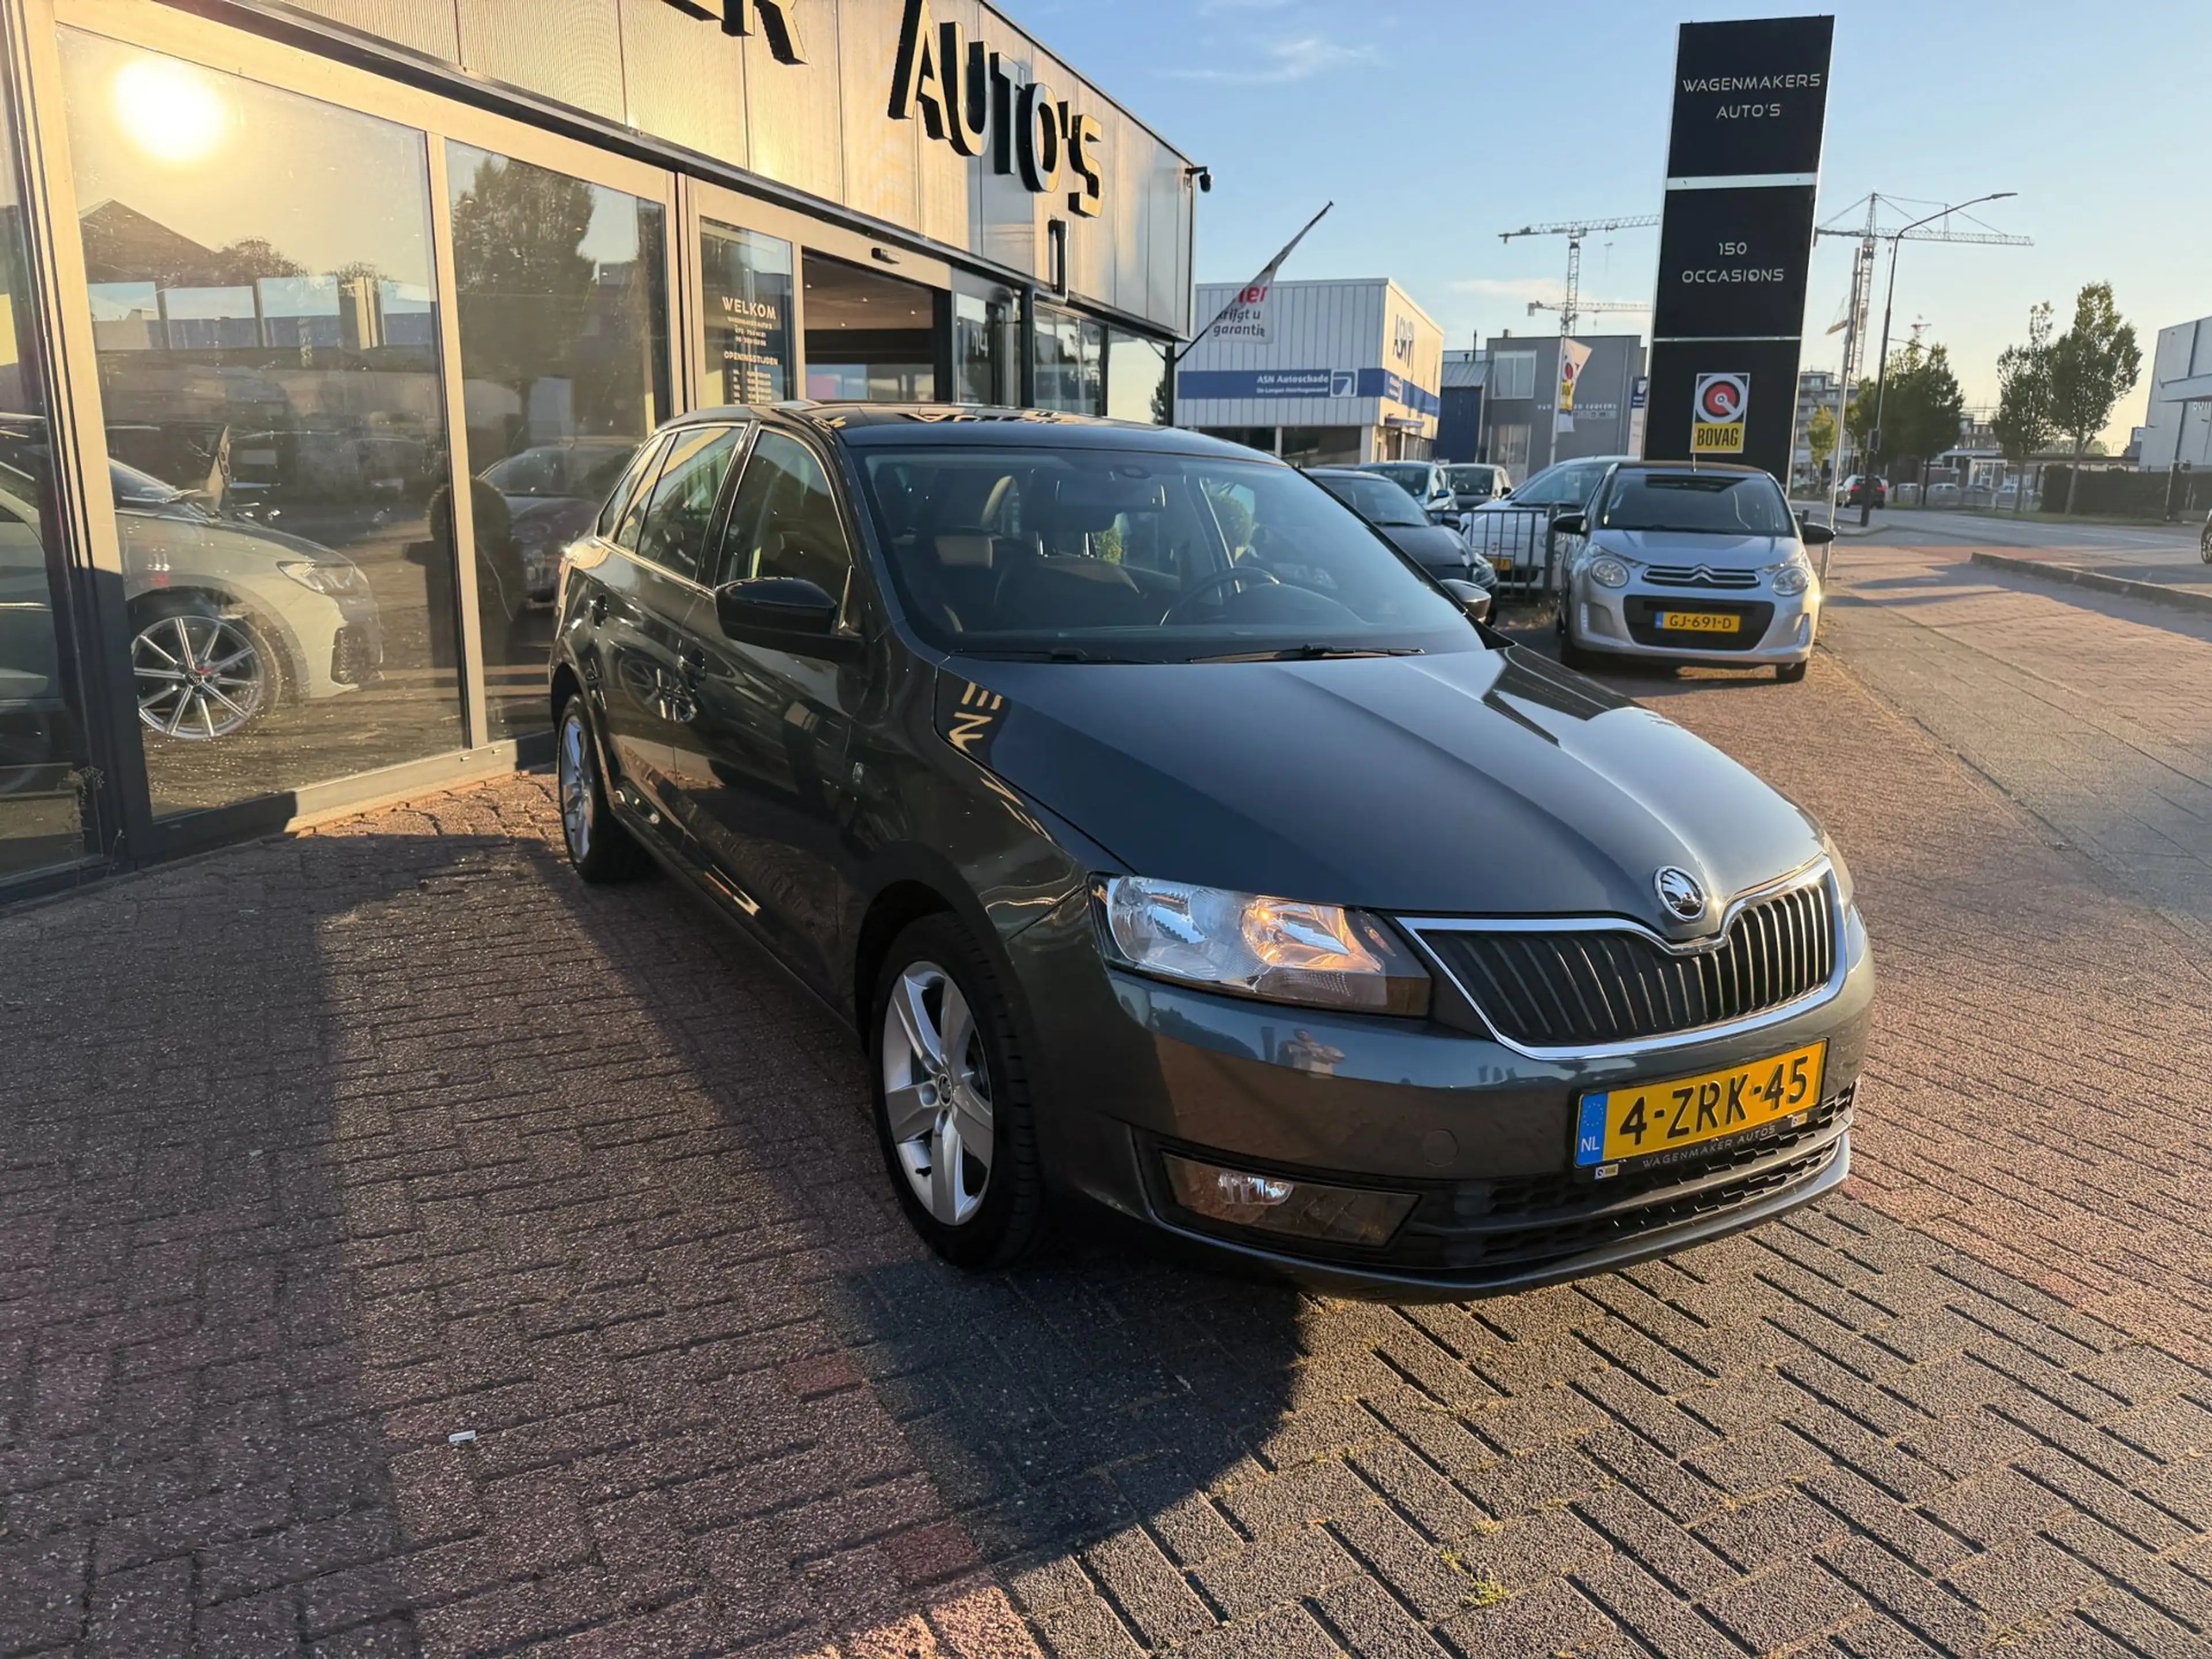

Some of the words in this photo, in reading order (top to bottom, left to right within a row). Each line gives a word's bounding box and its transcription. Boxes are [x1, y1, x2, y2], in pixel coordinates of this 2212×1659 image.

[1683, 73, 1821, 93] WAGENMAKERS
[1715, 103, 1781, 120] AUTO'S
[1718, 242, 1748, 255] 150
[1681, 268, 1785, 283] OCCASIONS
[722, 296, 777, 320] WELKOM
[1253, 310, 1260, 320] u
[1213, 324, 1266, 338] garantie
[1257, 376, 1274, 384] ASN
[1277, 374, 1328, 384] Autoschade
[1696, 427, 1738, 446] BOVAG
[1669, 615, 1732, 629] GJ-691-D
[1619, 1055, 1809, 1146] 4-ZRK-45
[1581, 1135, 1600, 1153] NL
[1642, 1137, 1733, 1169] WAGENMAKER
[1737, 1124, 1776, 1143] AUTOS
